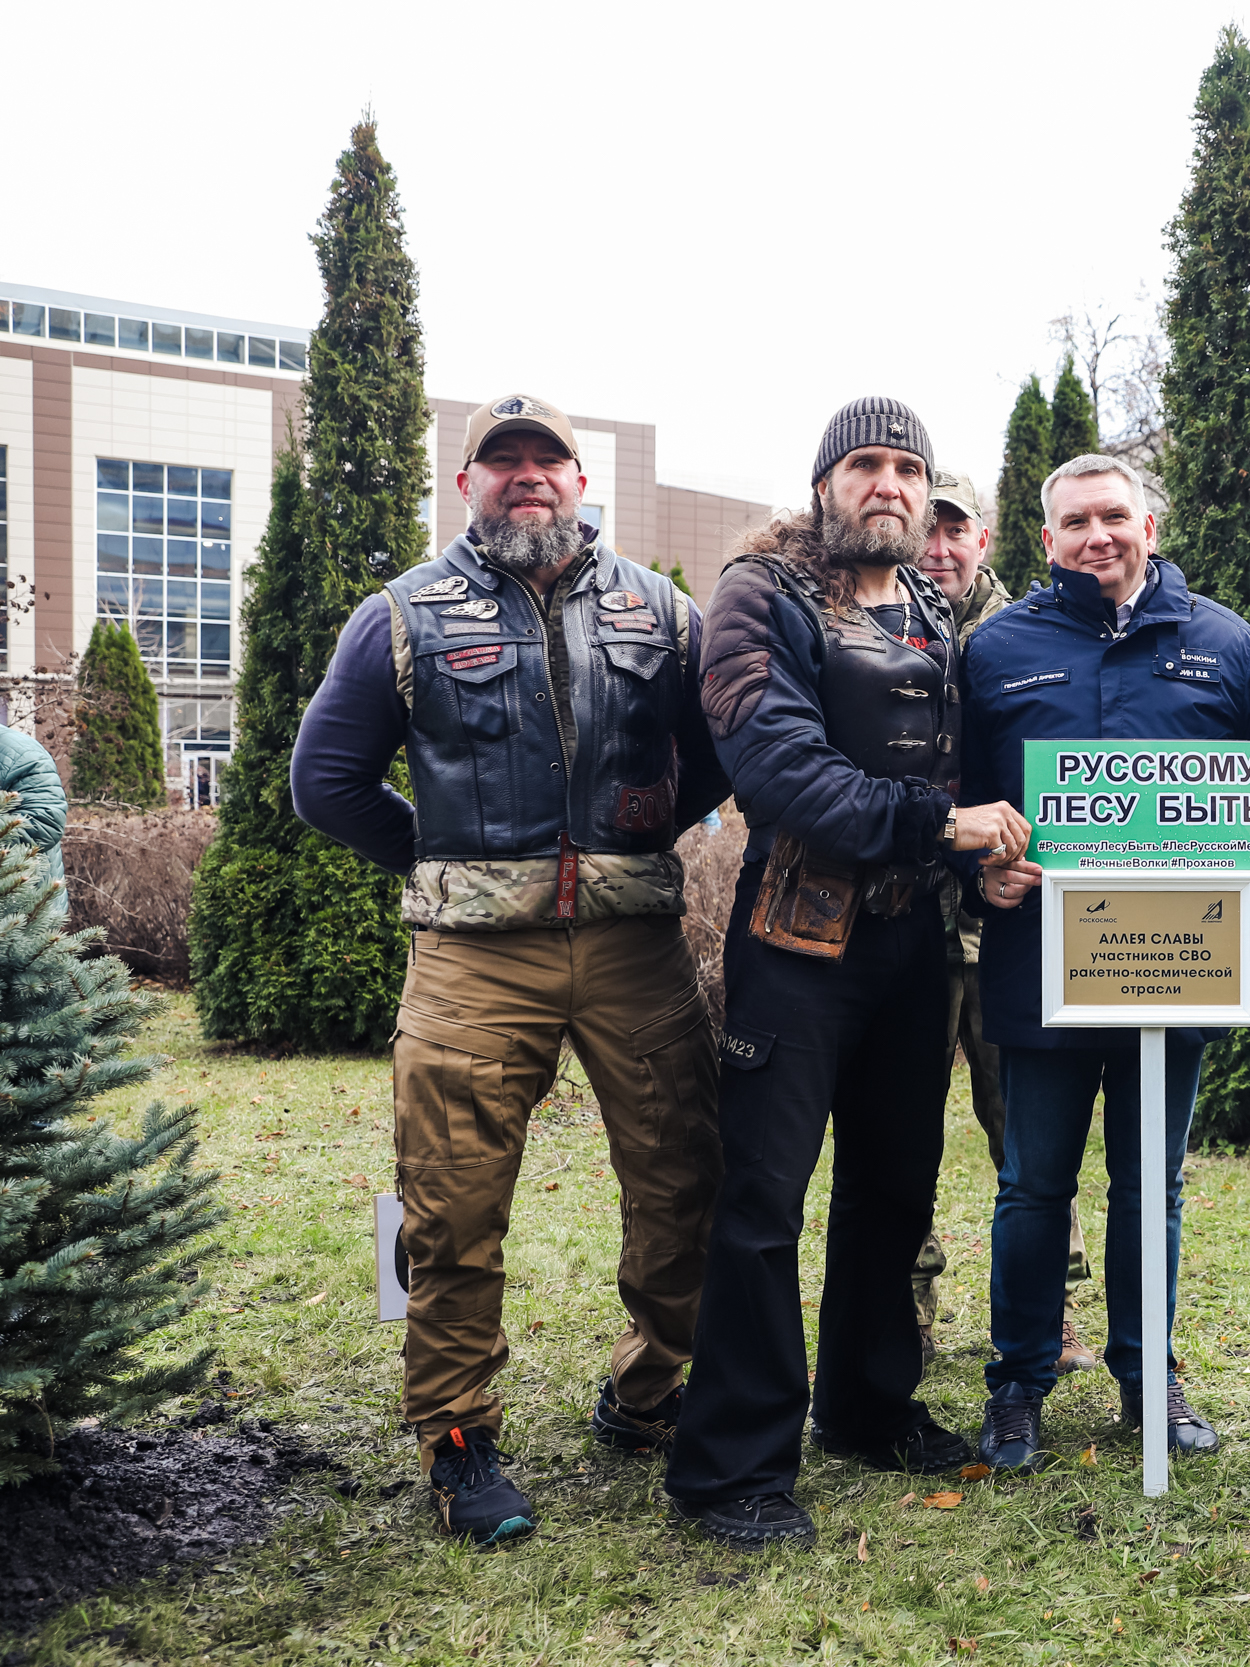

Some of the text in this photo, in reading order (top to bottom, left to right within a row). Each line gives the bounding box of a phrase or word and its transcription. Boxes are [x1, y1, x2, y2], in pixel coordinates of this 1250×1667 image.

[1180, 653, 1217, 664] ВОЧКИНА
[617, 788, 669, 828] РОС
[1037, 795, 1138, 824] ЛЕСУ
[1038, 841, 1159, 852] #РусскомуЛесуБыть
[1079, 858, 1235, 869] #НочныеВолки #Проханов
[1099, 933, 1204, 945] АЛЛЕЯ СЛАВЫ
[1090, 950, 1212, 963] участников СВО
[1069, 967, 1232, 980] ракетно-космической
[1121, 985, 1181, 997] отрасли
